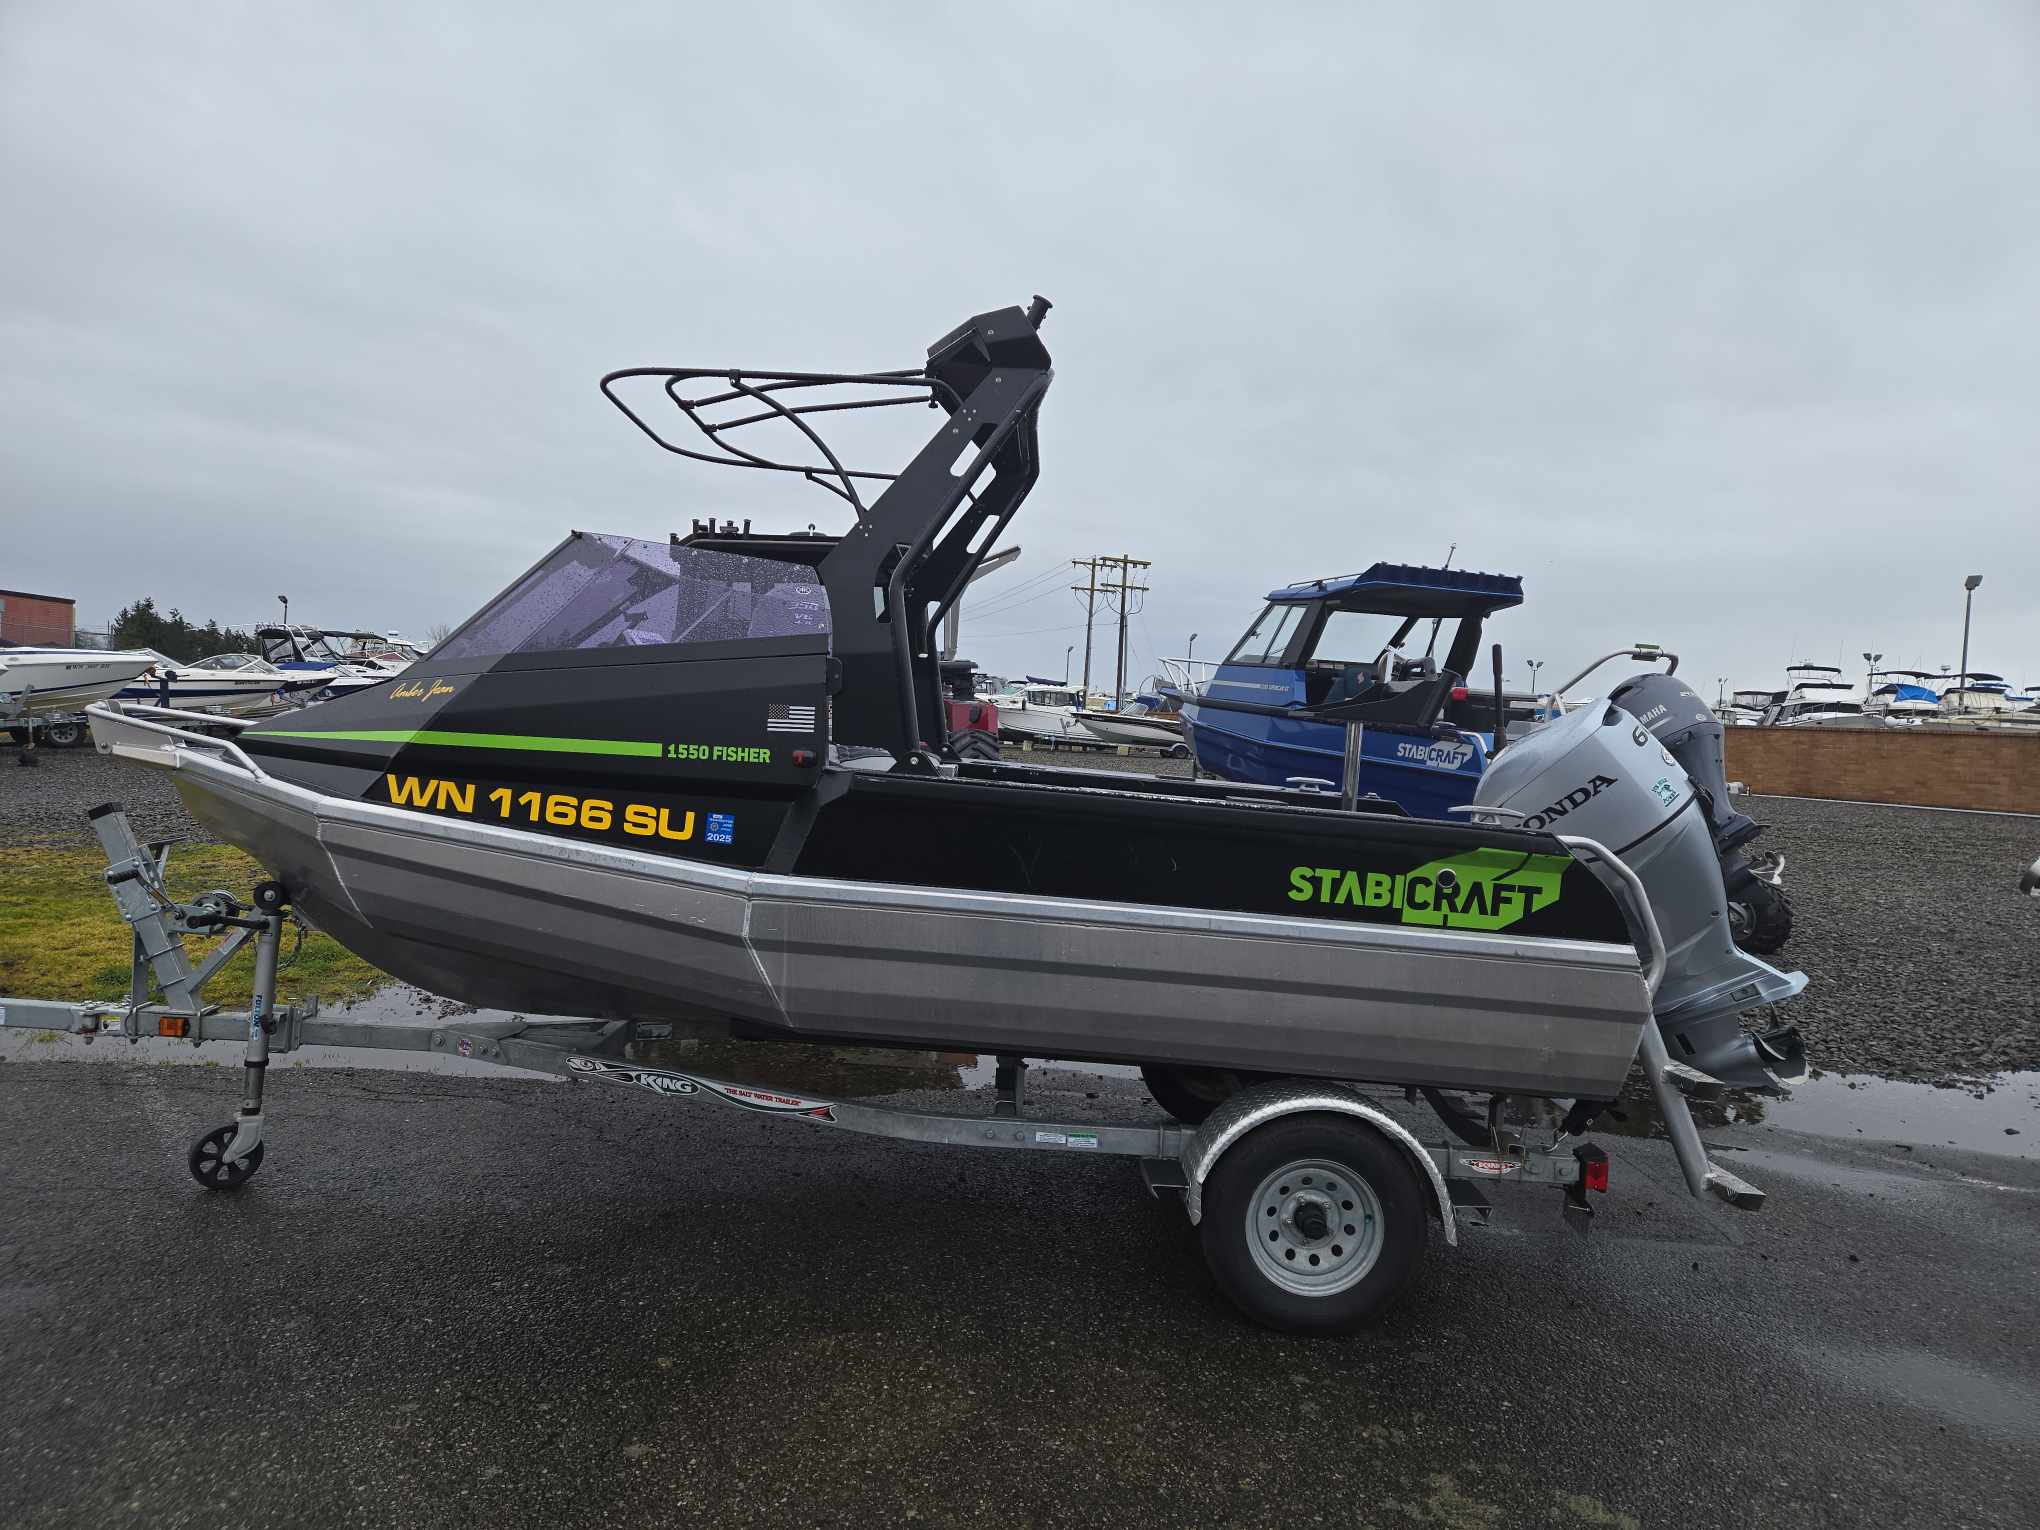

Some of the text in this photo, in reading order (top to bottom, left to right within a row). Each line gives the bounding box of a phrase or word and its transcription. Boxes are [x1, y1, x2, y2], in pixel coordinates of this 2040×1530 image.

[1640, 704, 1668, 725] MAHA
[667, 743, 771, 764] 1550 FISHER
[1397, 742, 1468, 764] STABICRAFT
[386, 773, 696, 841] WN 1166 SU
[1515, 774, 1619, 830] ONDA
[706, 832, 733, 843] 2025
[1287, 865, 1543, 918] STABICRAFT
[640, 1073, 693, 1095] KING
[753, 1091, 774, 1103] WATER
